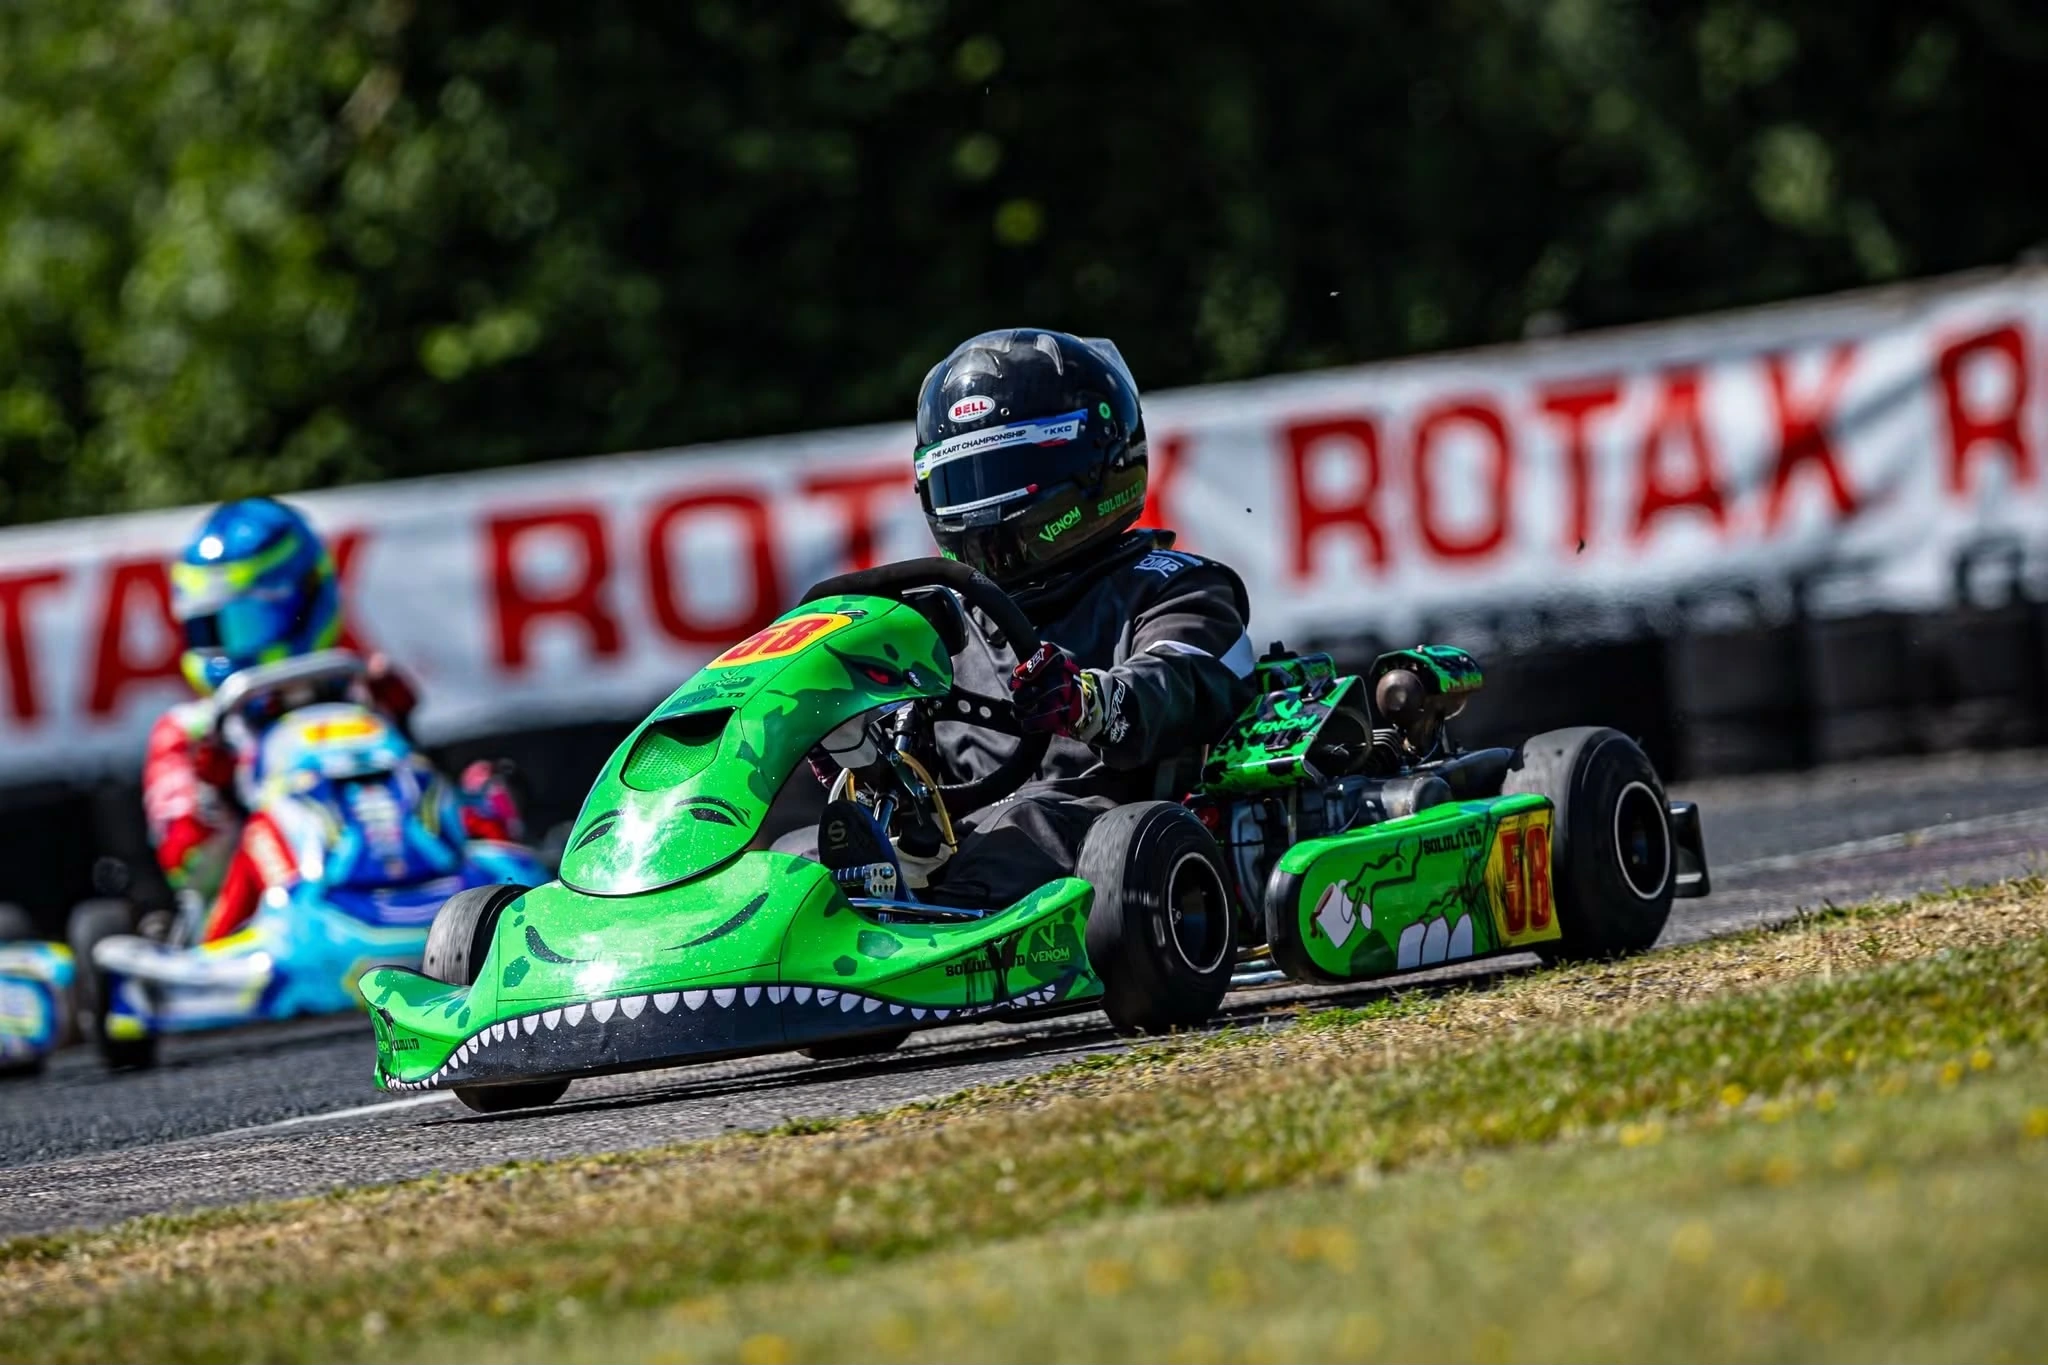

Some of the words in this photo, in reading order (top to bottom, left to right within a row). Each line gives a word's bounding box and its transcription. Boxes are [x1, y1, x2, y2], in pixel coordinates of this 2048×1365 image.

[955, 401, 987, 417] BELL
[931, 450, 942, 460] THE
[942, 443, 960, 456] KART
[961, 429, 1026, 450] CHAMPIONSHIP
[1274, 340, 1862, 590] ROTAX
[1038, 506, 1081, 542] VENOM
[1140, 558, 1179, 572] OMP
[718, 618, 833, 663] 58
[1239, 713, 1318, 737] VENOM
[1499, 823, 1550, 936] 58
[1031, 947, 1070, 963] VENOM
